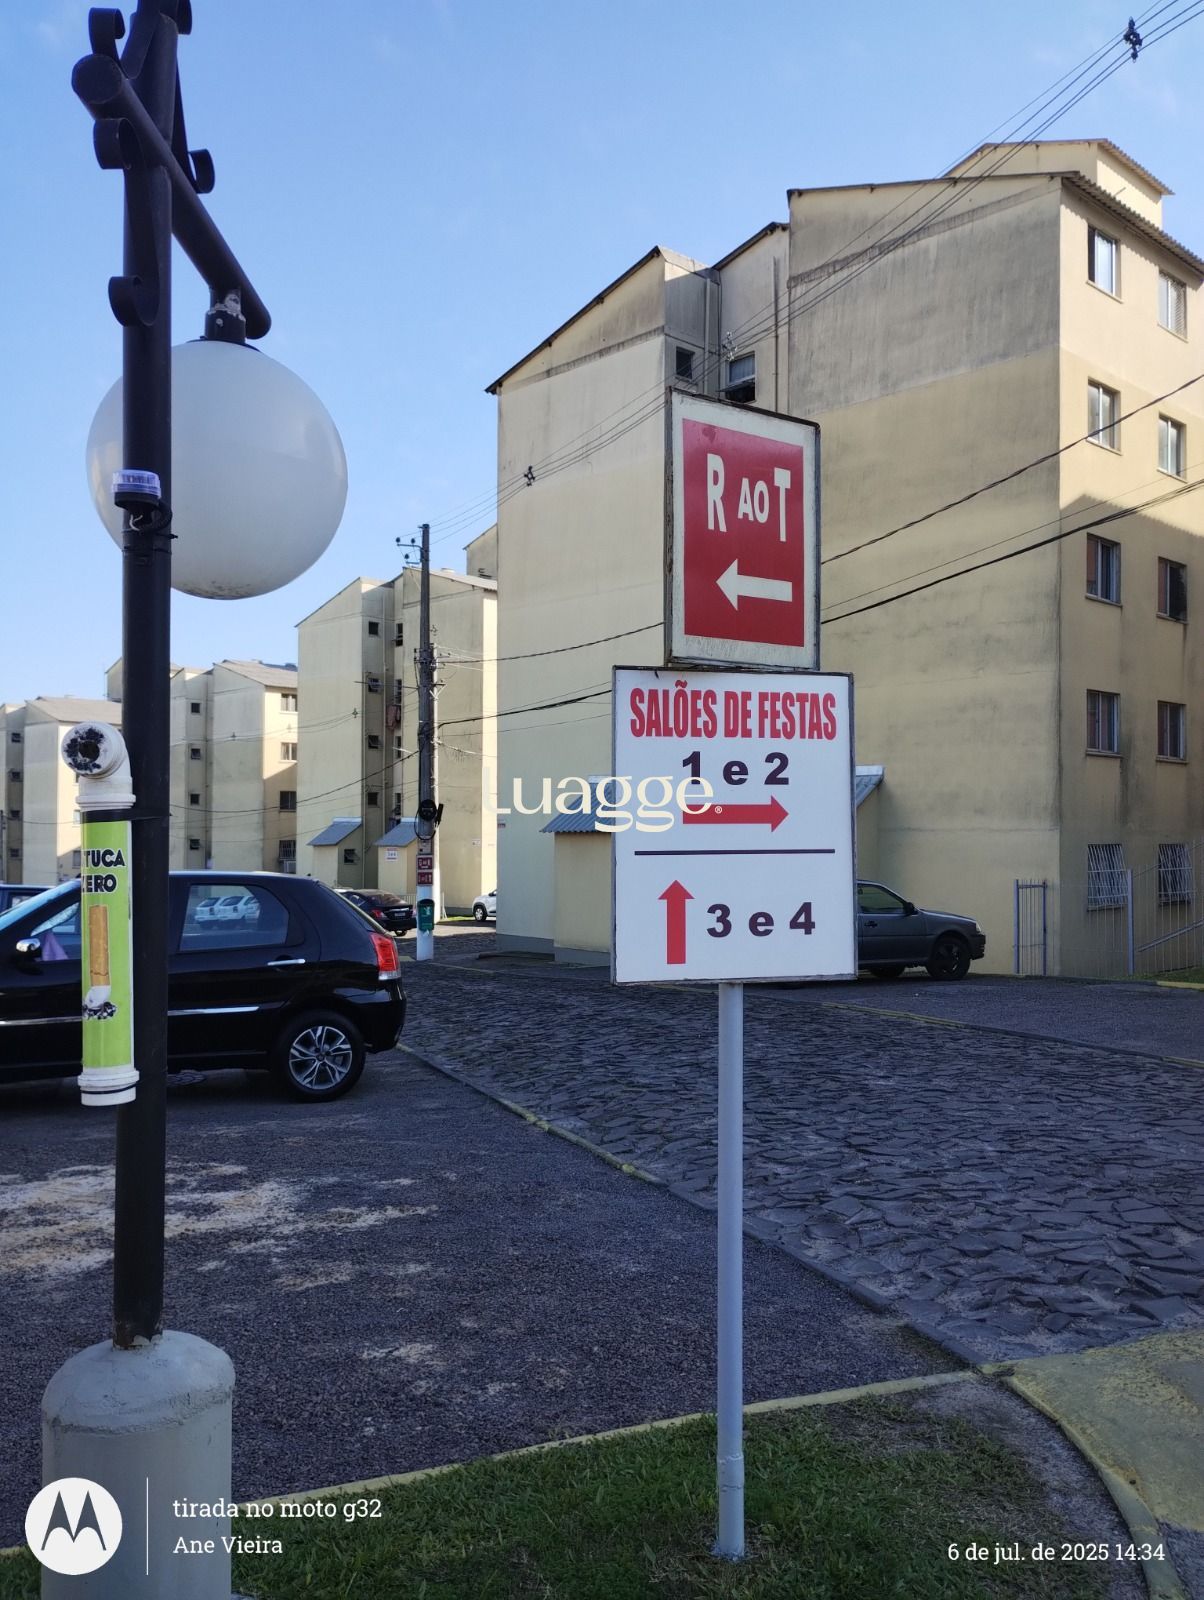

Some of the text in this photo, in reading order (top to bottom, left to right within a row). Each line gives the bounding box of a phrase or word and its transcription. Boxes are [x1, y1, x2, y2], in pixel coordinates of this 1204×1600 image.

[707, 453, 791, 542] R AO T
[630, 680, 836, 740] SALÕES DE FESTAS
[682, 751, 789, 785] 1 e 2
[706, 901, 815, 938] 3 e 4
